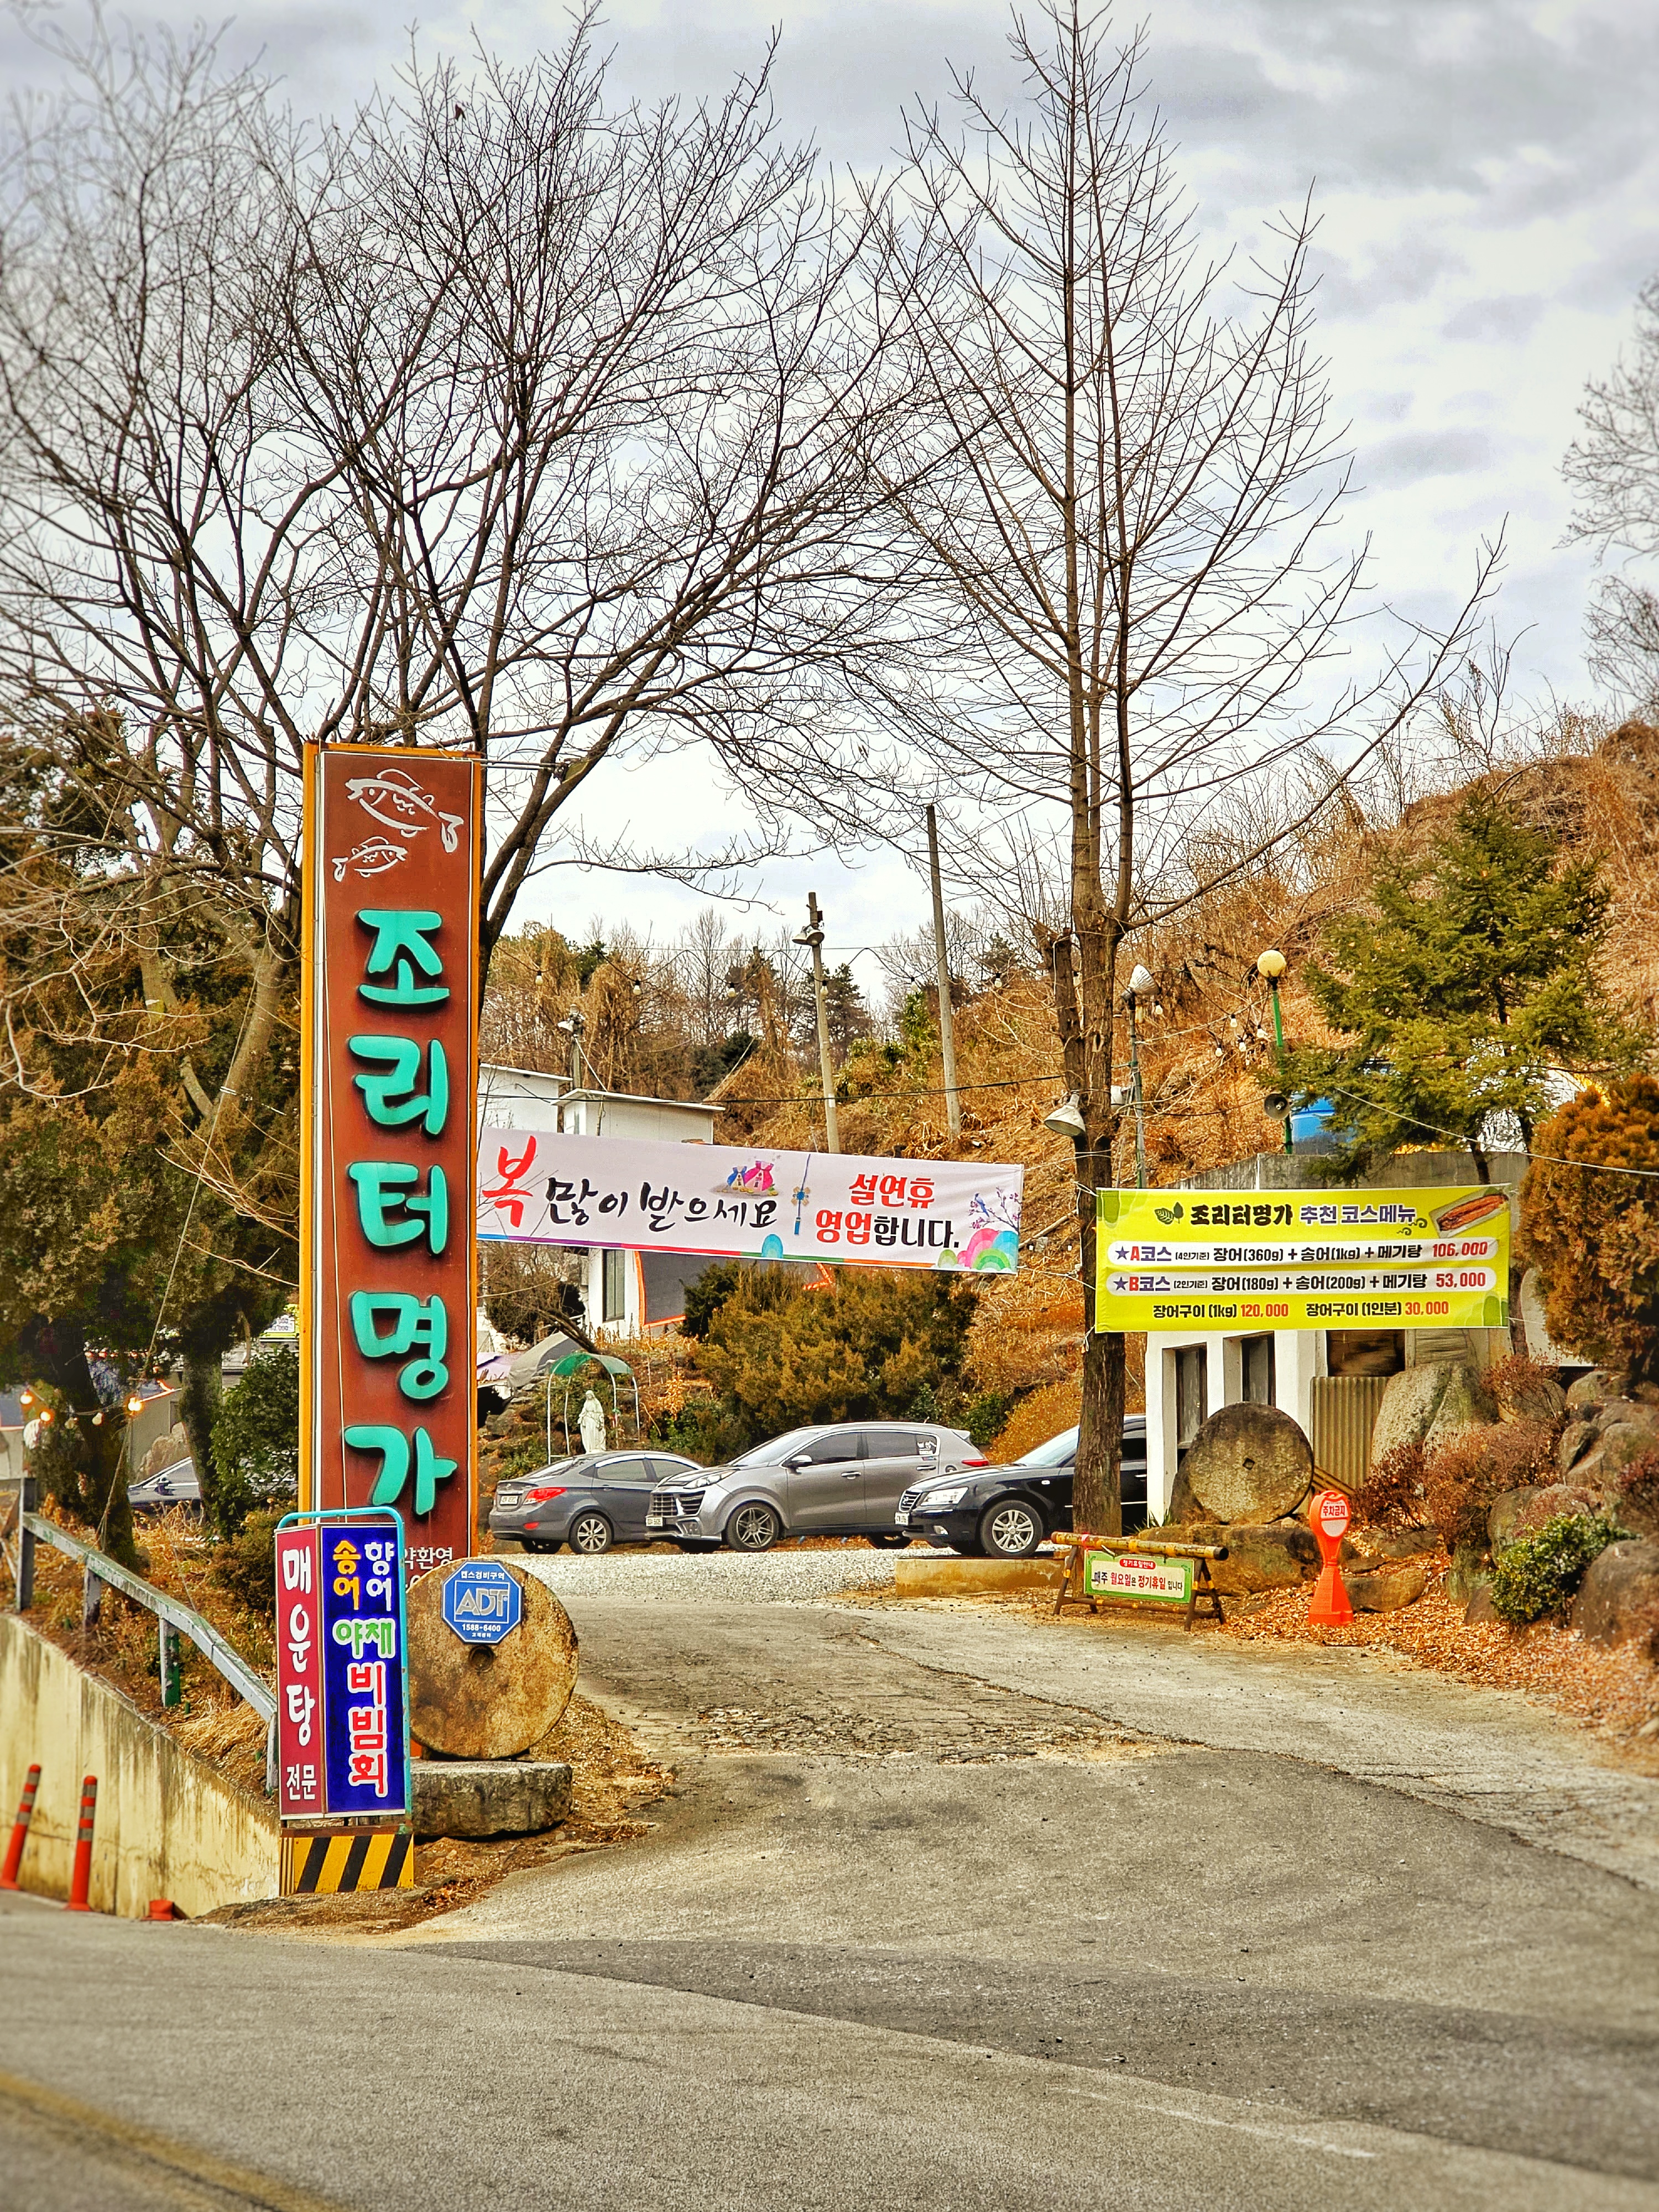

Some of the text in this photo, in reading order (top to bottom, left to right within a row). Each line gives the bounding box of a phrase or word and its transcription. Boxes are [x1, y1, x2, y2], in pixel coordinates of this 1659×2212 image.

[482, 1135, 777, 1232] 복 많이 받으세요
[849, 1174, 935, 1209] 설연휴
[344, 909, 457, 1515] 조리터명가
[816, 1209, 959, 1248] 영업합니다.
[1191, 1204, 1416, 1226] 조리터명가 추천 코스메뉴
[1130, 1246, 1171, 1261] A코스
[1175, 1252, 1209, 1260] (4인기준)
[1214, 1248, 1284, 1261] 장어(360g)
[1301, 1247, 1360, 1261] 송어(1kg)
[1378, 1244, 1422, 1258] 메기탕
[1432, 1241, 1488, 1258] 106,000
[1129, 1276, 1170, 1291] B코스
[1173, 1280, 1208, 1289] (2인기준)
[1212, 1276, 1279, 1291] 장어(180g)
[1296, 1275, 1365, 1290] 송어(200g)
[1383, 1274, 1427, 1288] 메기탕
[1436, 1272, 1486, 1288] 53,000
[1154, 1303, 1288, 1318] 장어구이 (1kg) 120,000
[1306, 1301, 1449, 1317] 장어구이 (1인분) 30,000
[1323, 1506, 1345, 1516] 주차금지
[333, 1540, 361, 1610] 송어
[365, 1541, 395, 1611] 향어
[1094, 1571, 1183, 1591] 매주 월요일은 정기휴일 입니다
[456, 1588, 509, 1616] ADT
[332, 1618, 396, 1658] 야채
[462, 1624, 501, 1632] 1588-6400
[282, 1546, 315, 1746] 매운탕
[347, 1661, 388, 1798] 비빔회
[286, 1764, 317, 1801] 전문
